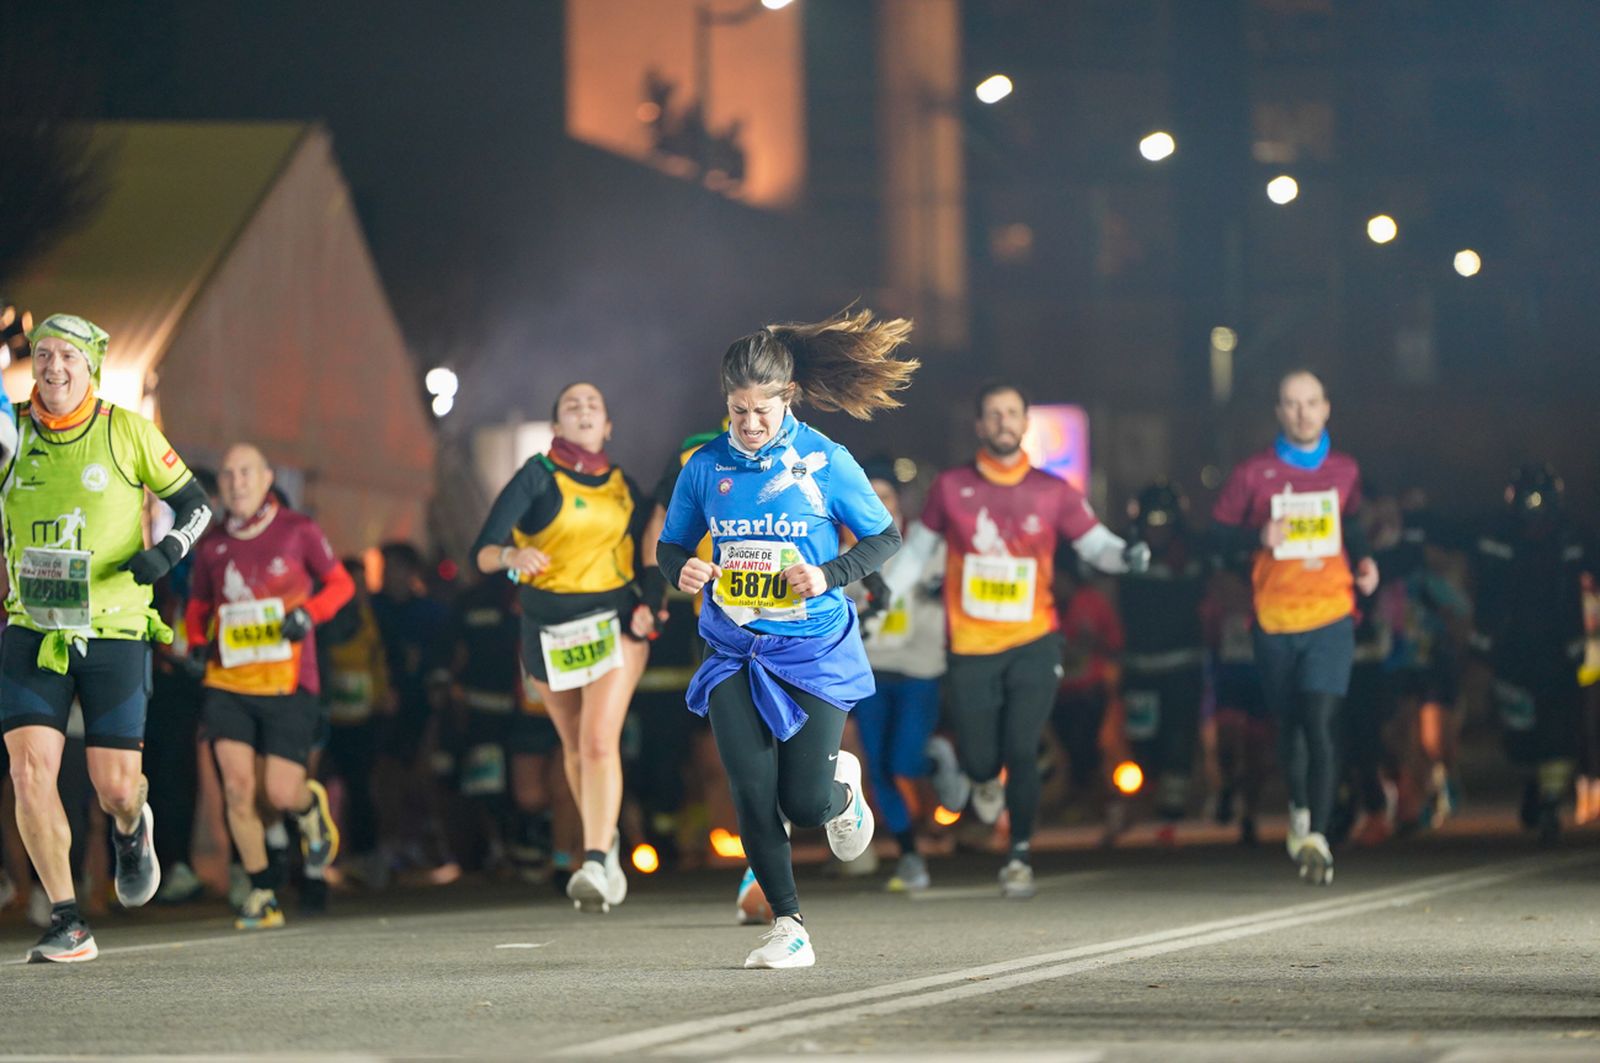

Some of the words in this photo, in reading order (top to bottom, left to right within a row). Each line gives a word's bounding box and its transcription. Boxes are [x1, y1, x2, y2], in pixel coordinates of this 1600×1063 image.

[709, 512, 808, 538] Axarlón
[761, 552, 773, 560] DE
[723, 560, 740, 570] SAN
[730, 571, 787, 599] 5870
[738, 599, 757, 607] Isabel
